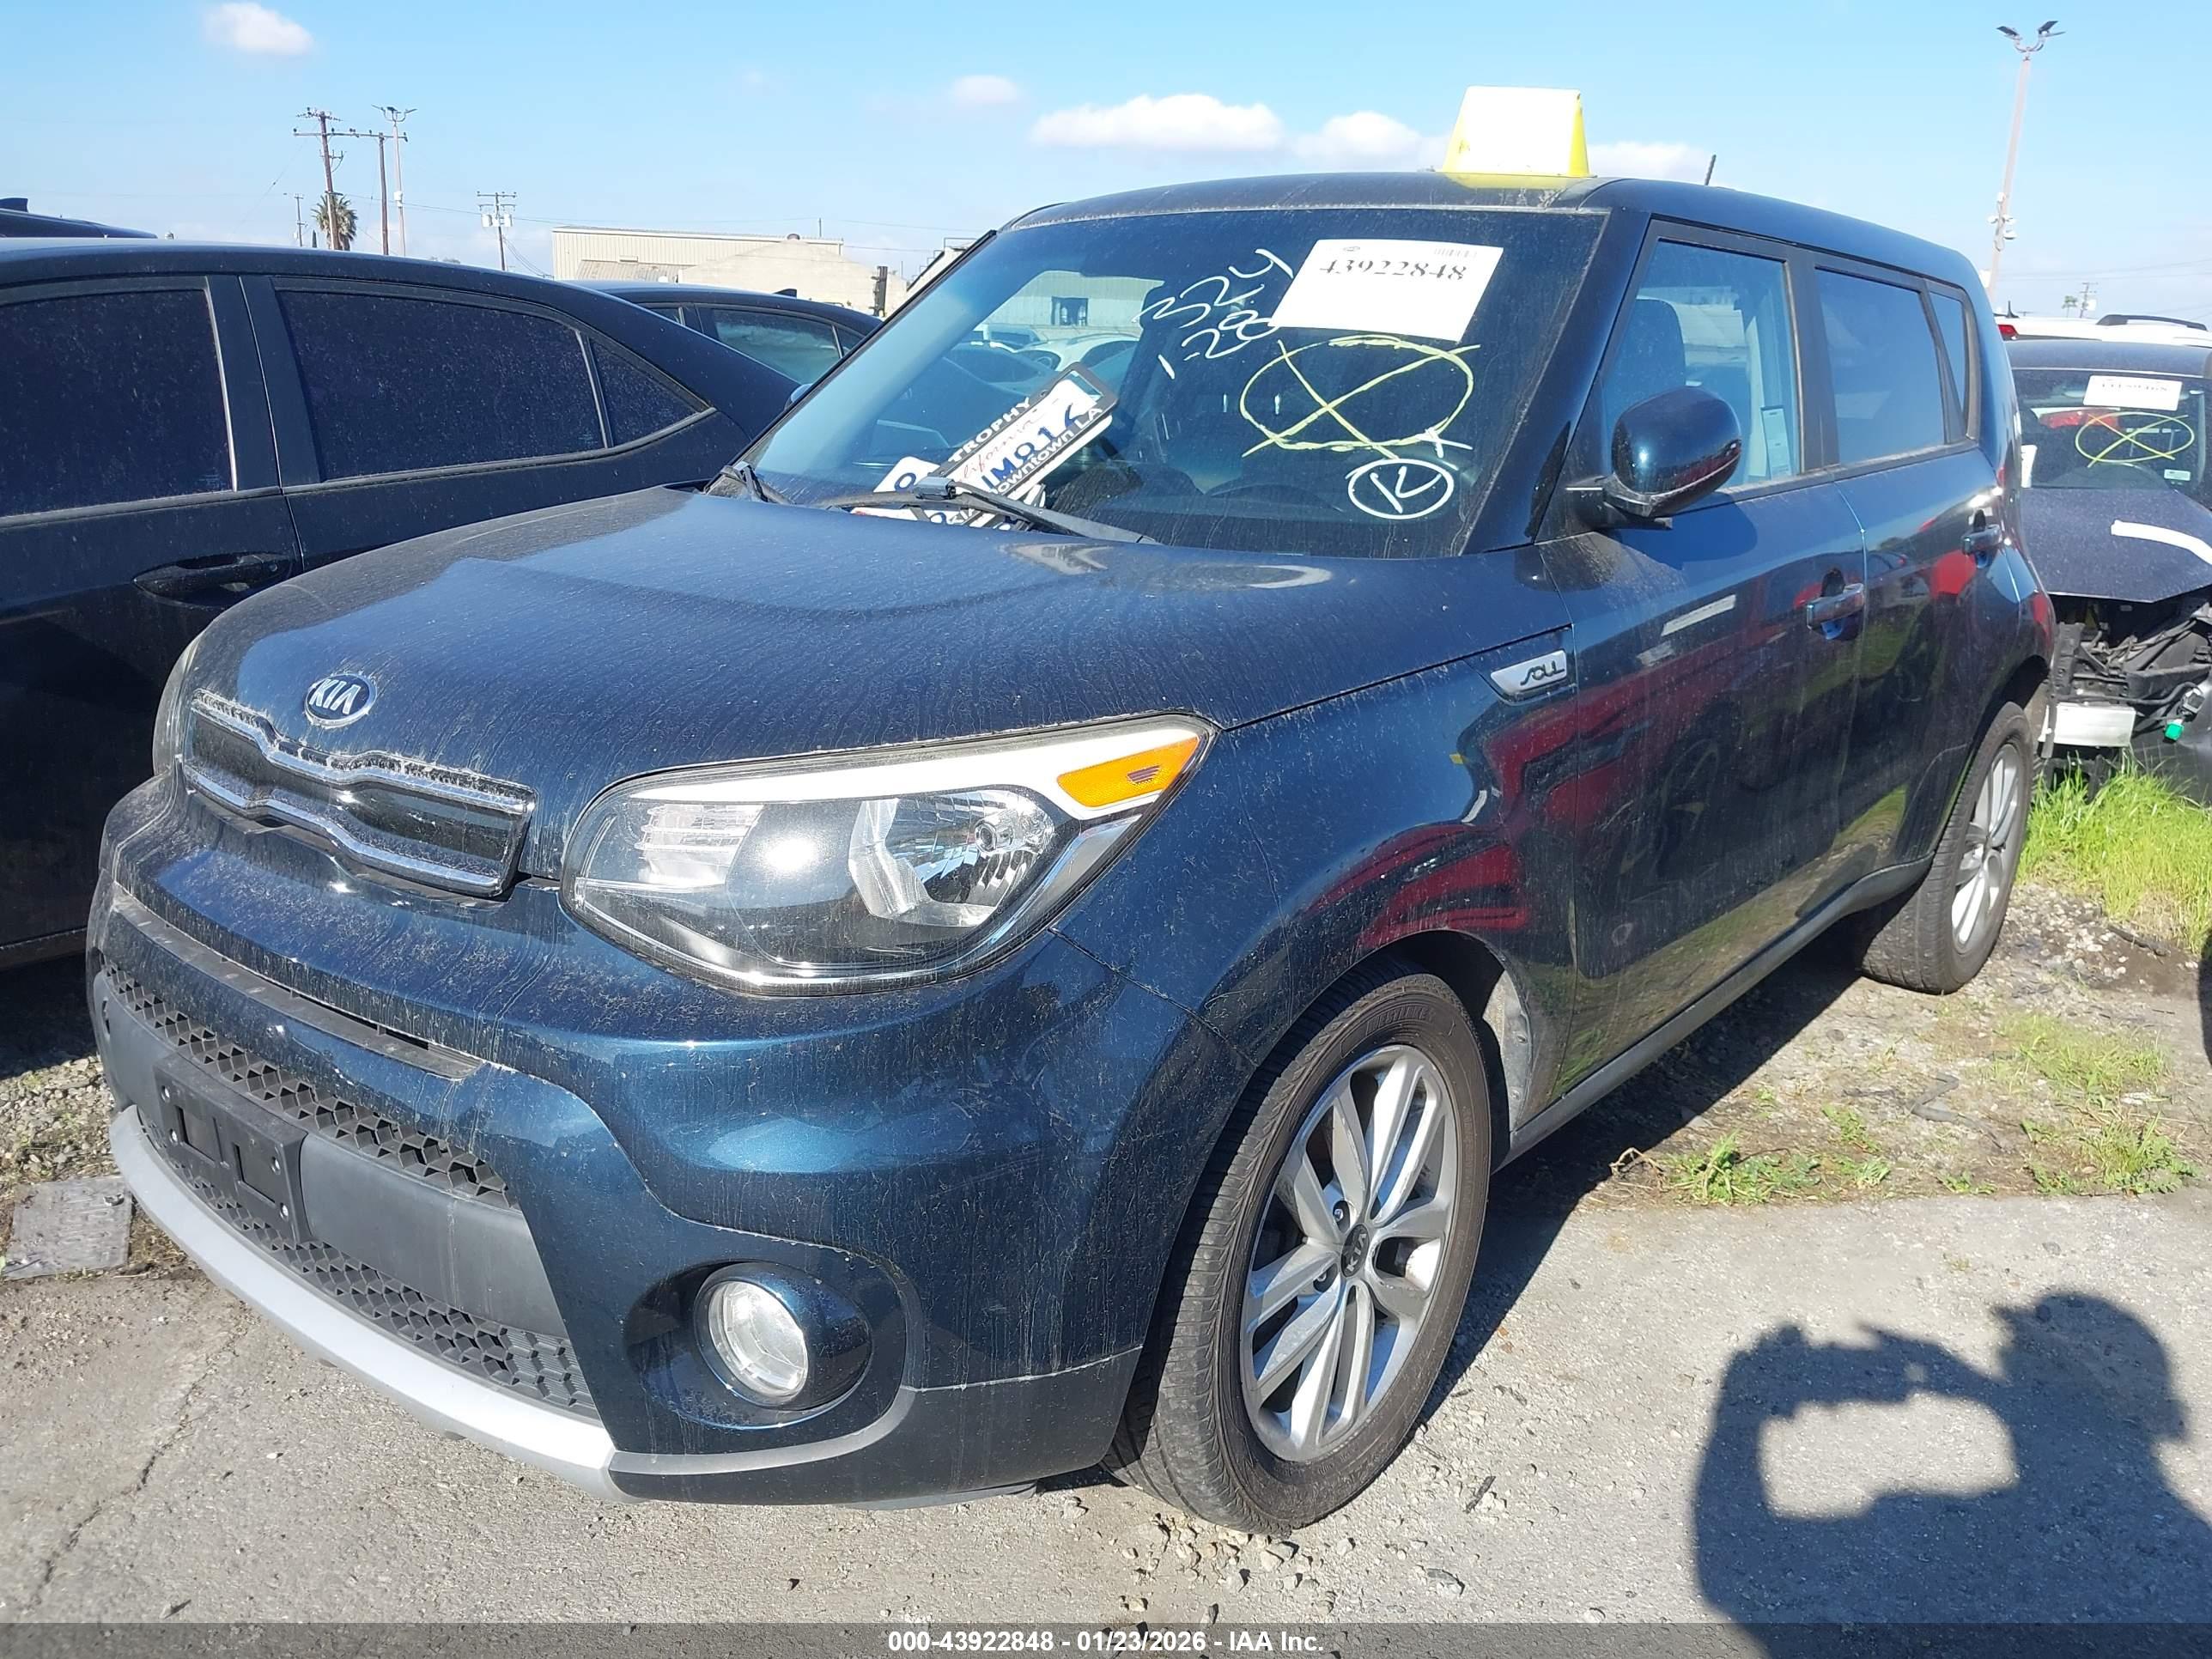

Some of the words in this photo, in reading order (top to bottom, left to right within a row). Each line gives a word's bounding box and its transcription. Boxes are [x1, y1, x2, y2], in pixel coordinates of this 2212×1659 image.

[1319, 258, 1467, 280] 43922848
[1132, 249, 1293, 329] 324
[948, 397, 1030, 464] TROPHY
[1075, 408, 1103, 428] LA
[309, 679, 361, 714] KIA
[1346, 1233, 1366, 1272] KIA
